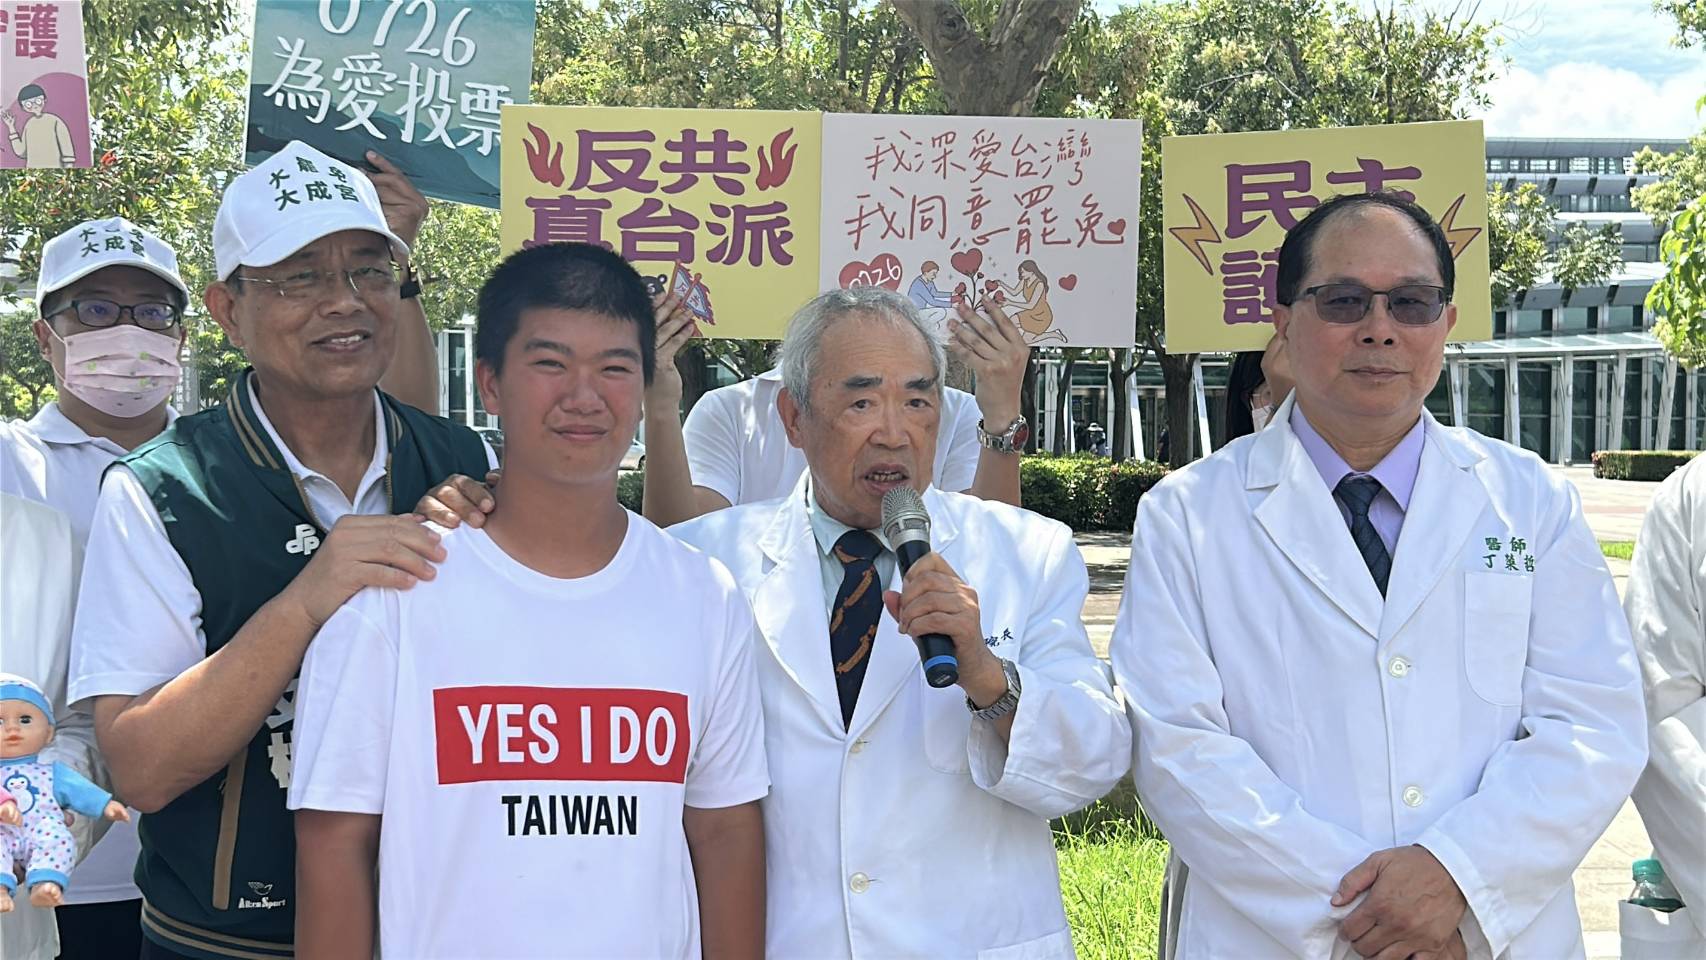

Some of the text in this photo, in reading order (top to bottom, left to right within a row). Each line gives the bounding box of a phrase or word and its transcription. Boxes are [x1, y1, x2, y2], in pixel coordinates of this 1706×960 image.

[0, 3, 59, 59] 護
[263, 35, 514, 157] 為愛投票
[567, 128, 751, 196] 反共
[864, 128, 1092, 186] 我深愛台灣
[522, 194, 794, 267] 真台派
[1484, 536, 1527, 555] 醫師
[457, 703, 677, 766] YES I DO
[501, 795, 638, 836] TAIWAN
